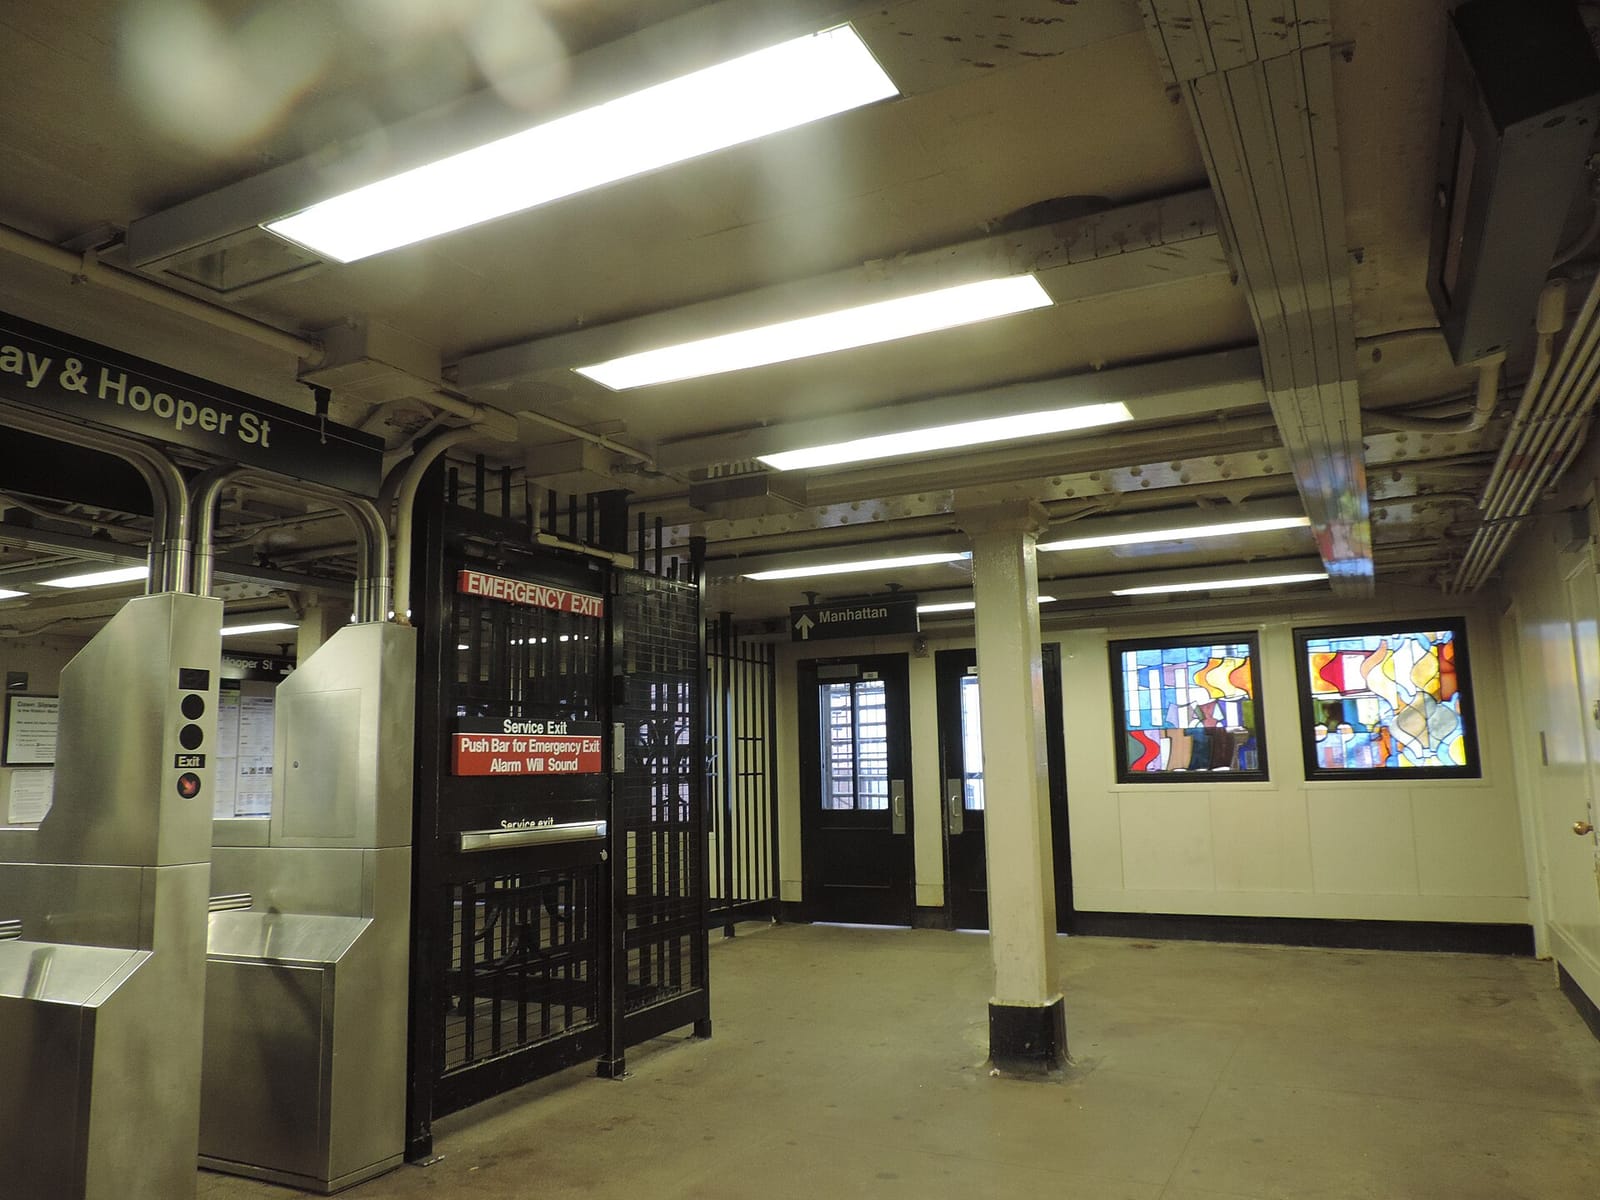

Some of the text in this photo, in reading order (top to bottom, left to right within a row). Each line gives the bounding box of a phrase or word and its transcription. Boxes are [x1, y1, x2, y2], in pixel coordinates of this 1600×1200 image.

[59, 358, 87, 394] &
[98, 367, 232, 434] Hooper
[237, 412, 271, 448] St
[468, 573, 601, 617] EMERGENCY EXIT
[819, 607, 888, 623] Manhattan
[503, 719, 567, 735] Service Exit
[461, 738, 600, 755] Push Bar for Emergency Exit
[178, 756, 200, 767] Exit
[490, 758, 578, 772] Alarm Will Sound
[500, 817, 554, 829] Service exit
